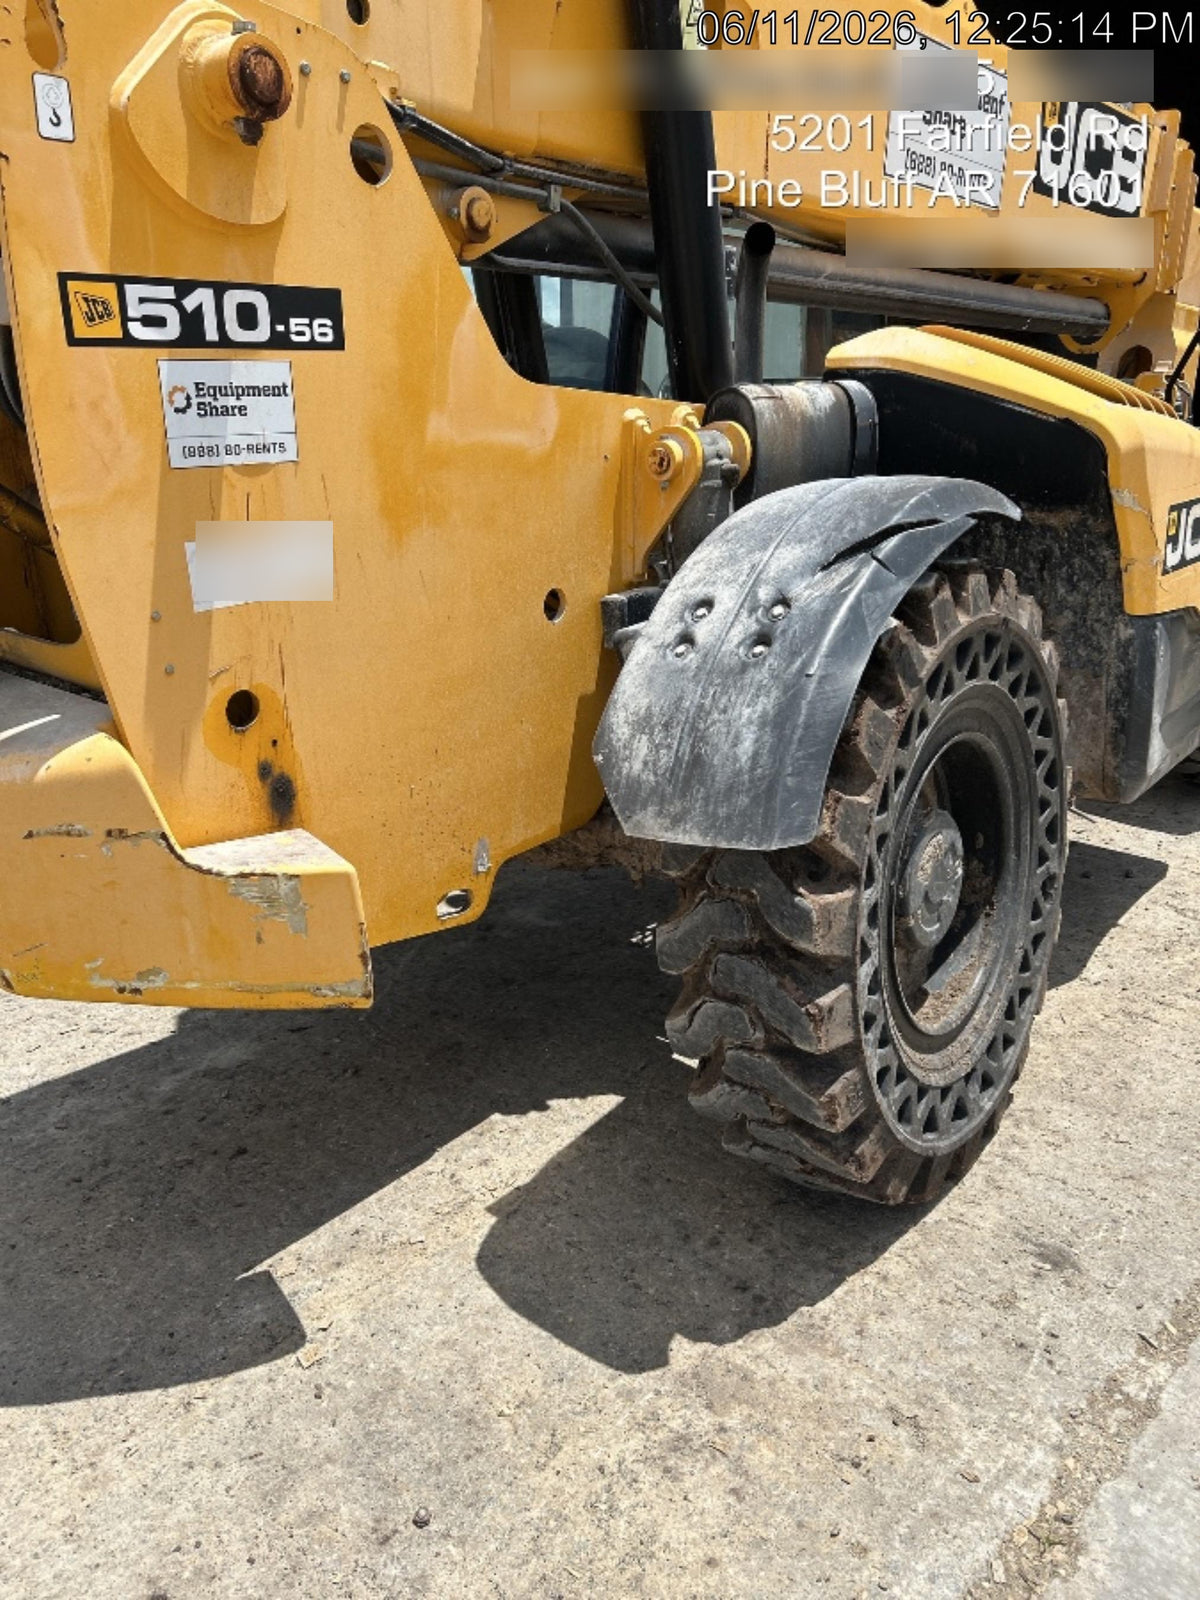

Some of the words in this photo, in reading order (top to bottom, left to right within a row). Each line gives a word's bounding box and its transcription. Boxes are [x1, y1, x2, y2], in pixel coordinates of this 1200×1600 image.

[82, 296, 114, 323] JCB
[193, 381, 289, 401] Equipment
[196, 402, 248, 418] Share
[224, 442, 287, 456] 80-RENTS
